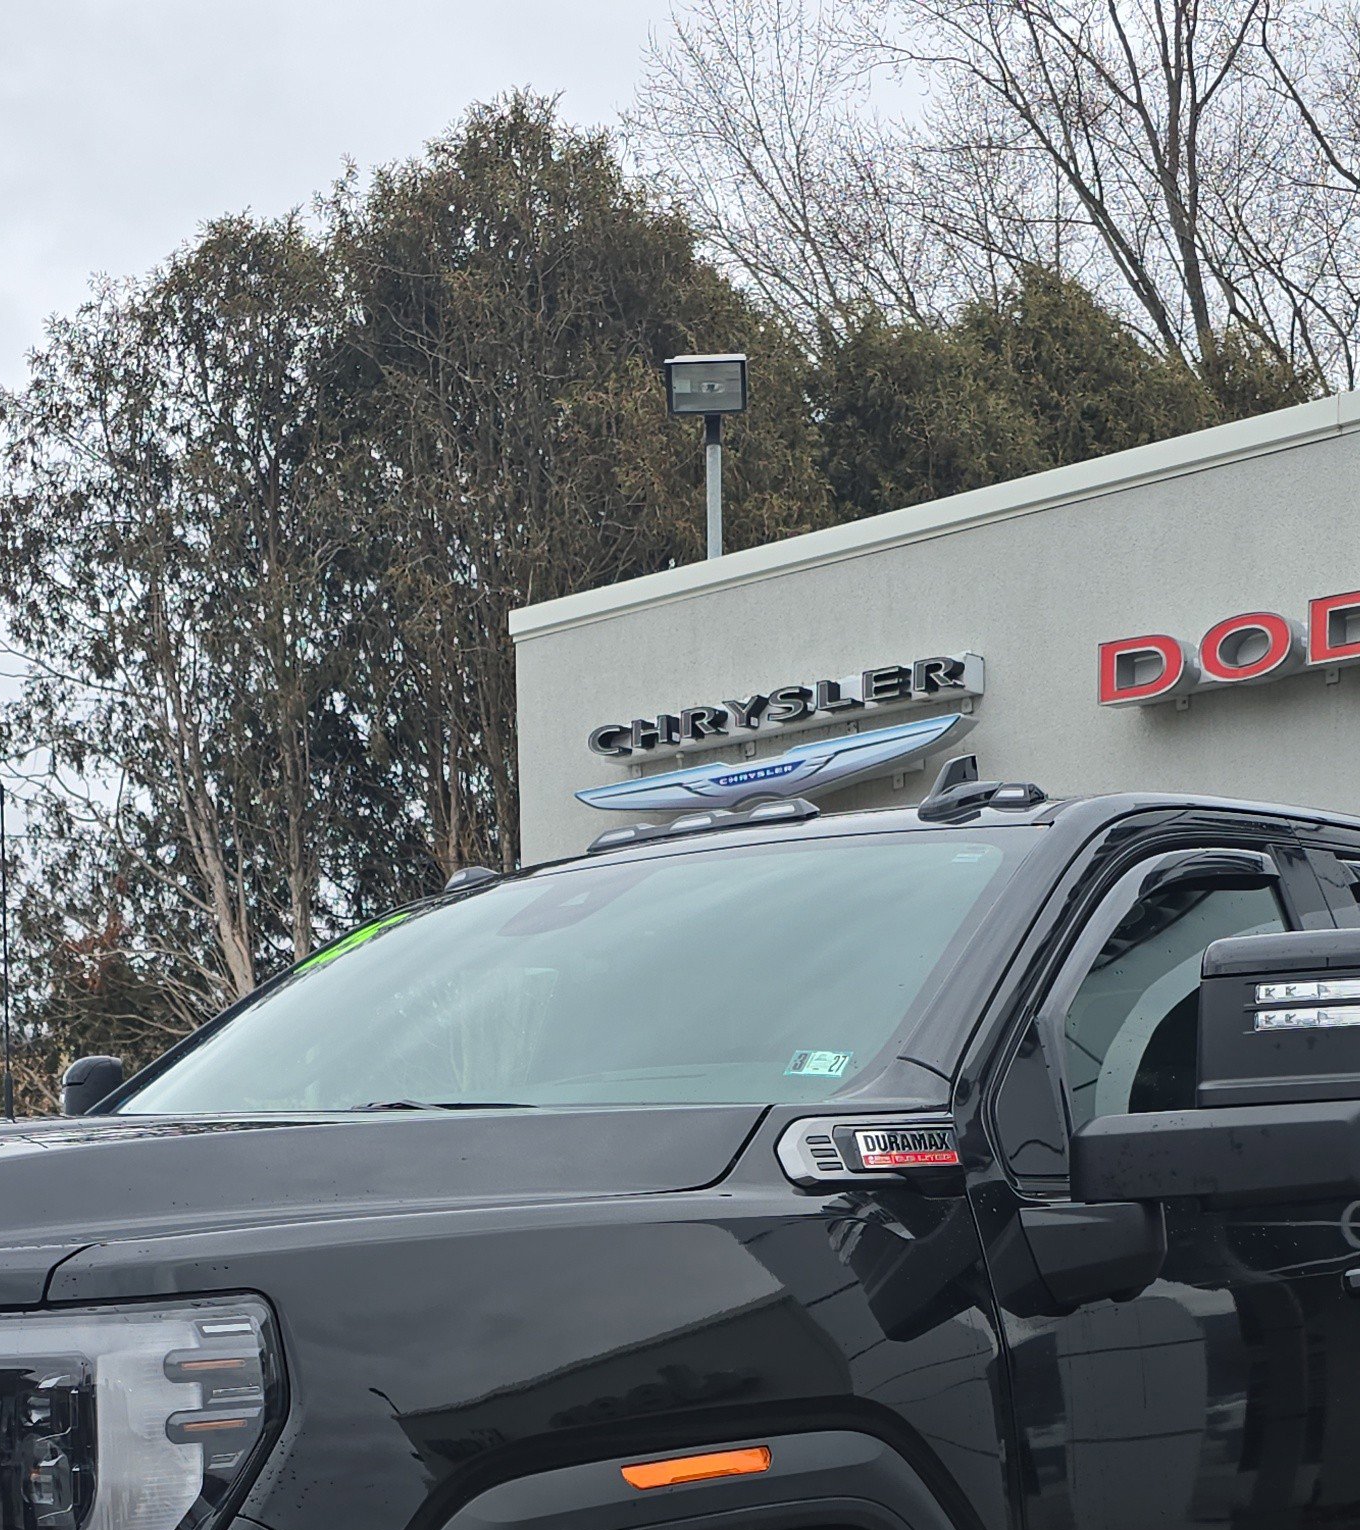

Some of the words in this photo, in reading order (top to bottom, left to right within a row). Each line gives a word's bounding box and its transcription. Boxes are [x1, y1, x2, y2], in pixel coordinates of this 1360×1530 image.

[588, 656, 966, 757] CHRYSLER
[719, 764, 793, 786] CHRYSLER
[792, 1053, 808, 1071] 3
[828, 1055, 848, 1073] 27
[863, 1132, 951, 1152] DURAMAX
